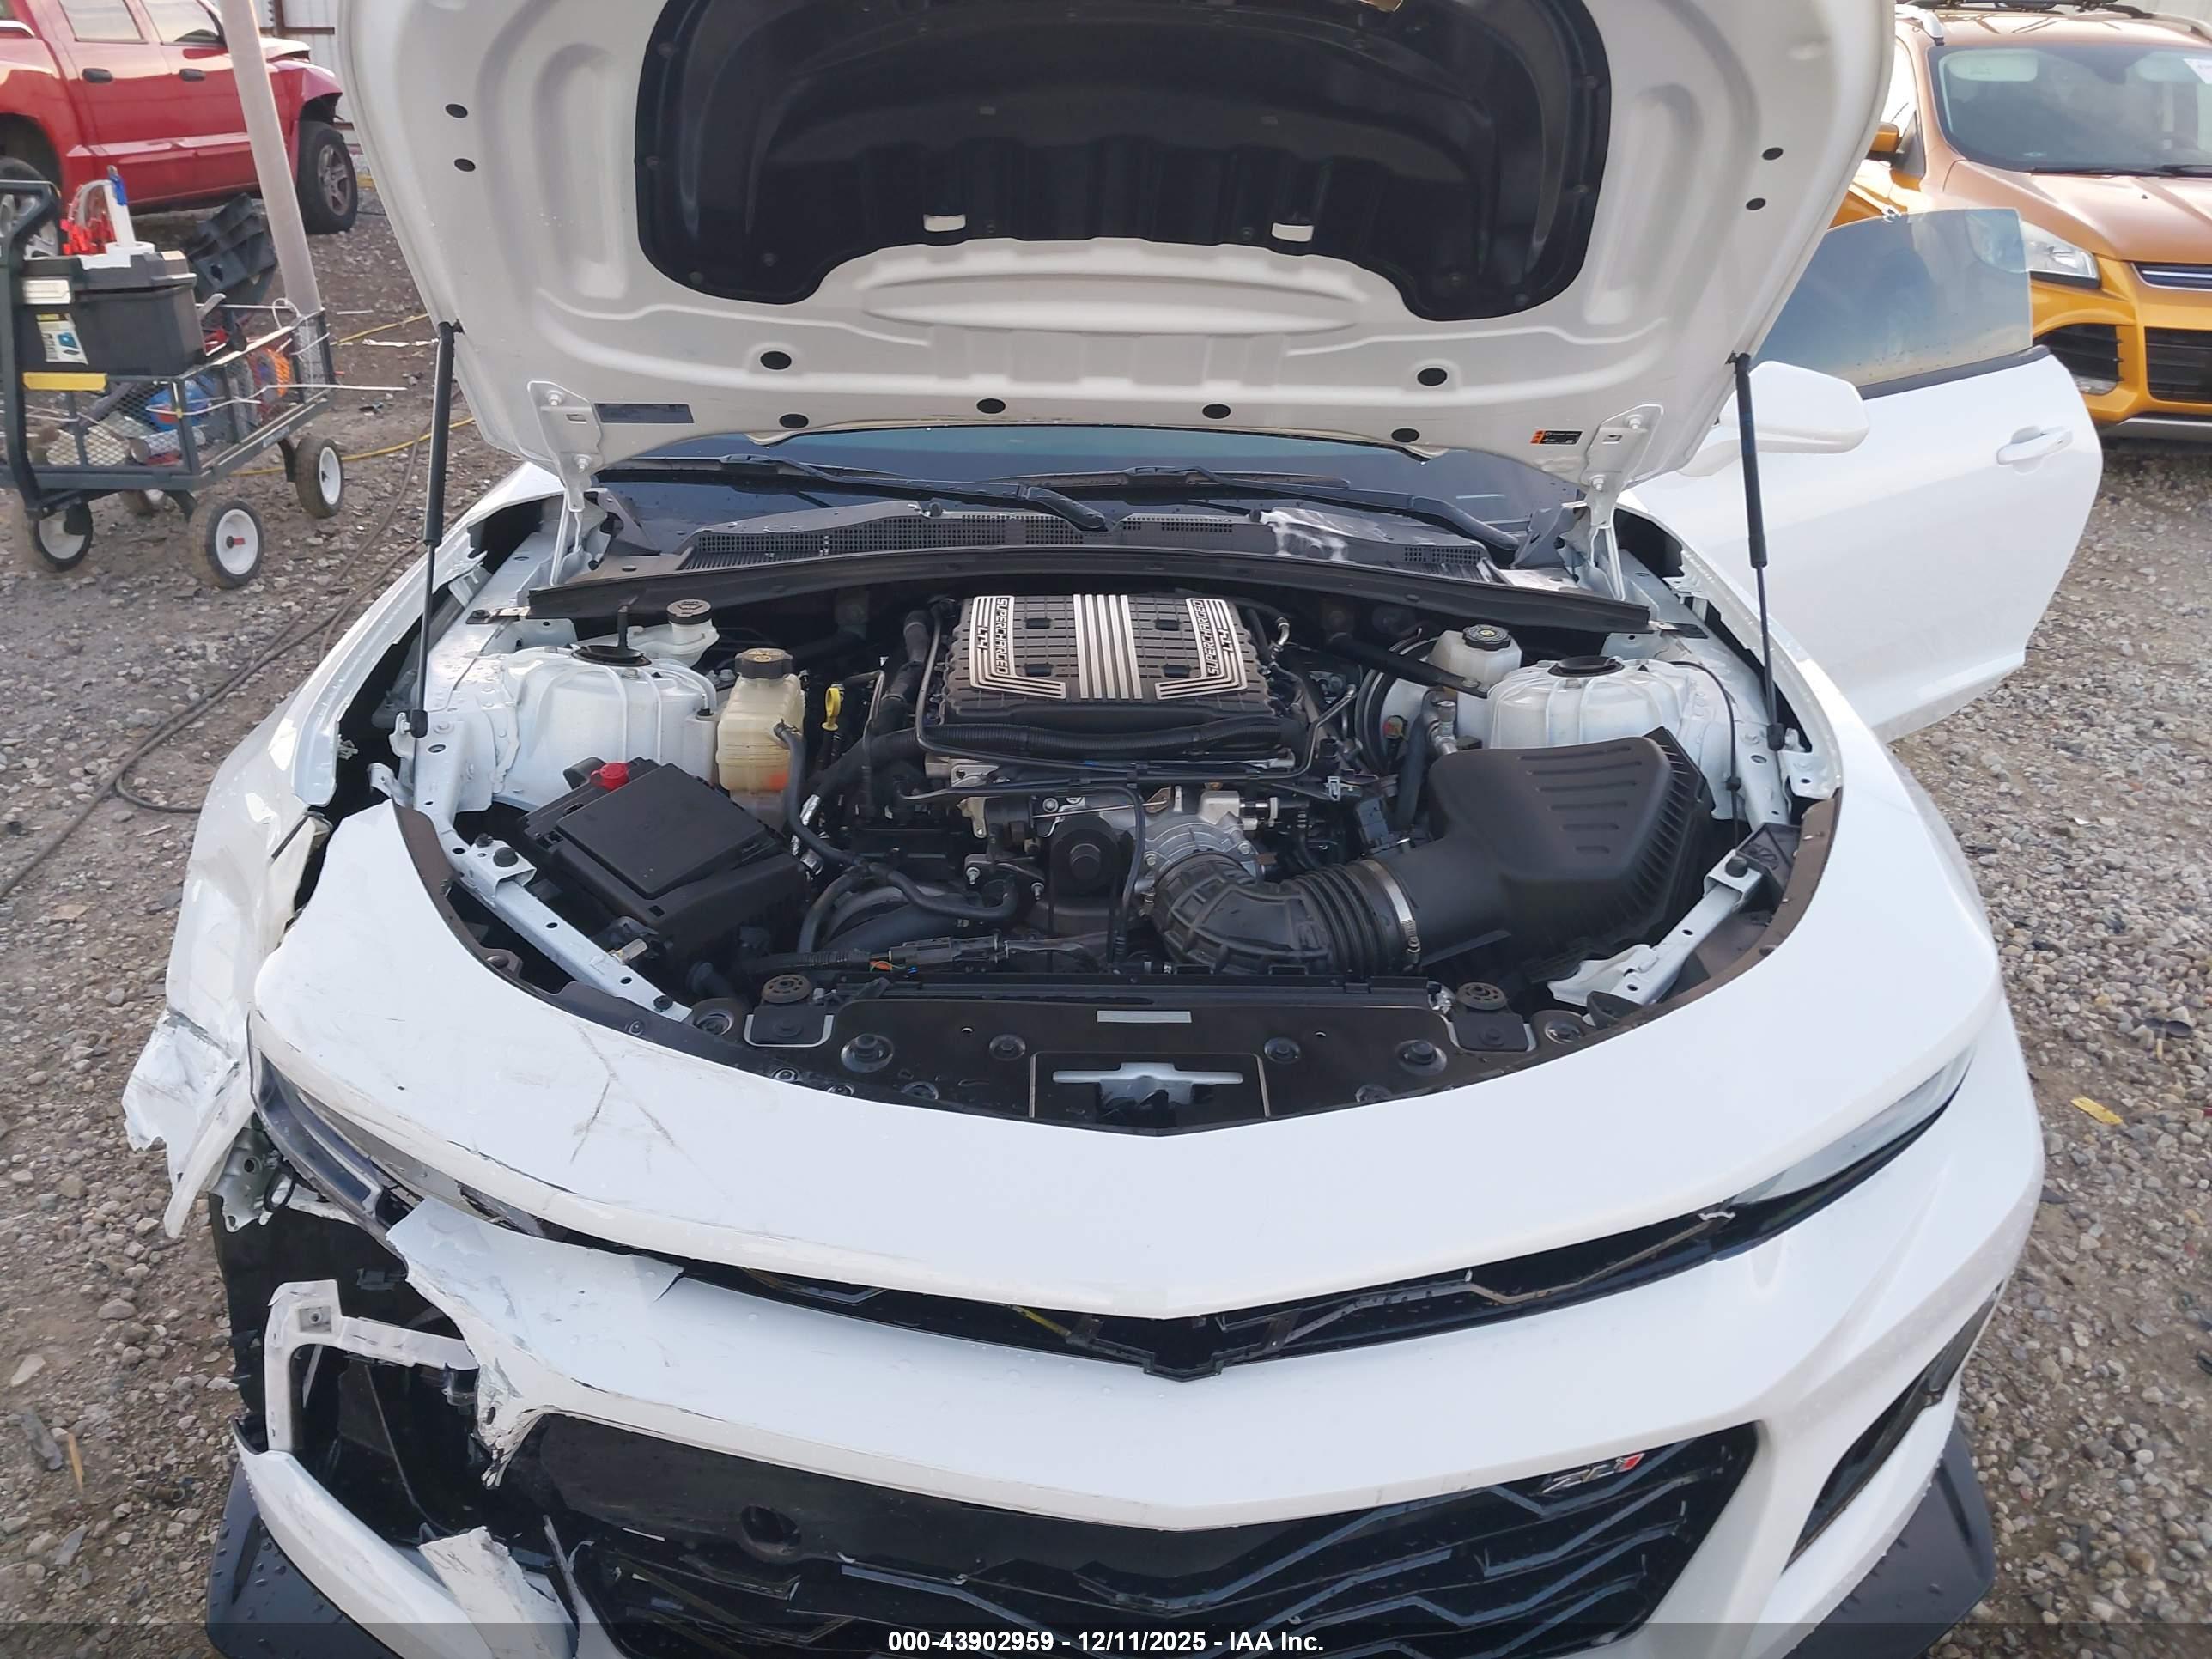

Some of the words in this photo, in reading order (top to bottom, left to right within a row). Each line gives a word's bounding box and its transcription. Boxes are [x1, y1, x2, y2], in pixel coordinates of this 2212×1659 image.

[976, 626, 988, 650] LT4
[994, 598, 1009, 675] SUPERCHARGED
[1192, 599, 1220, 676] SUPERCHARGED
[1218, 628, 1234, 653] LT4
